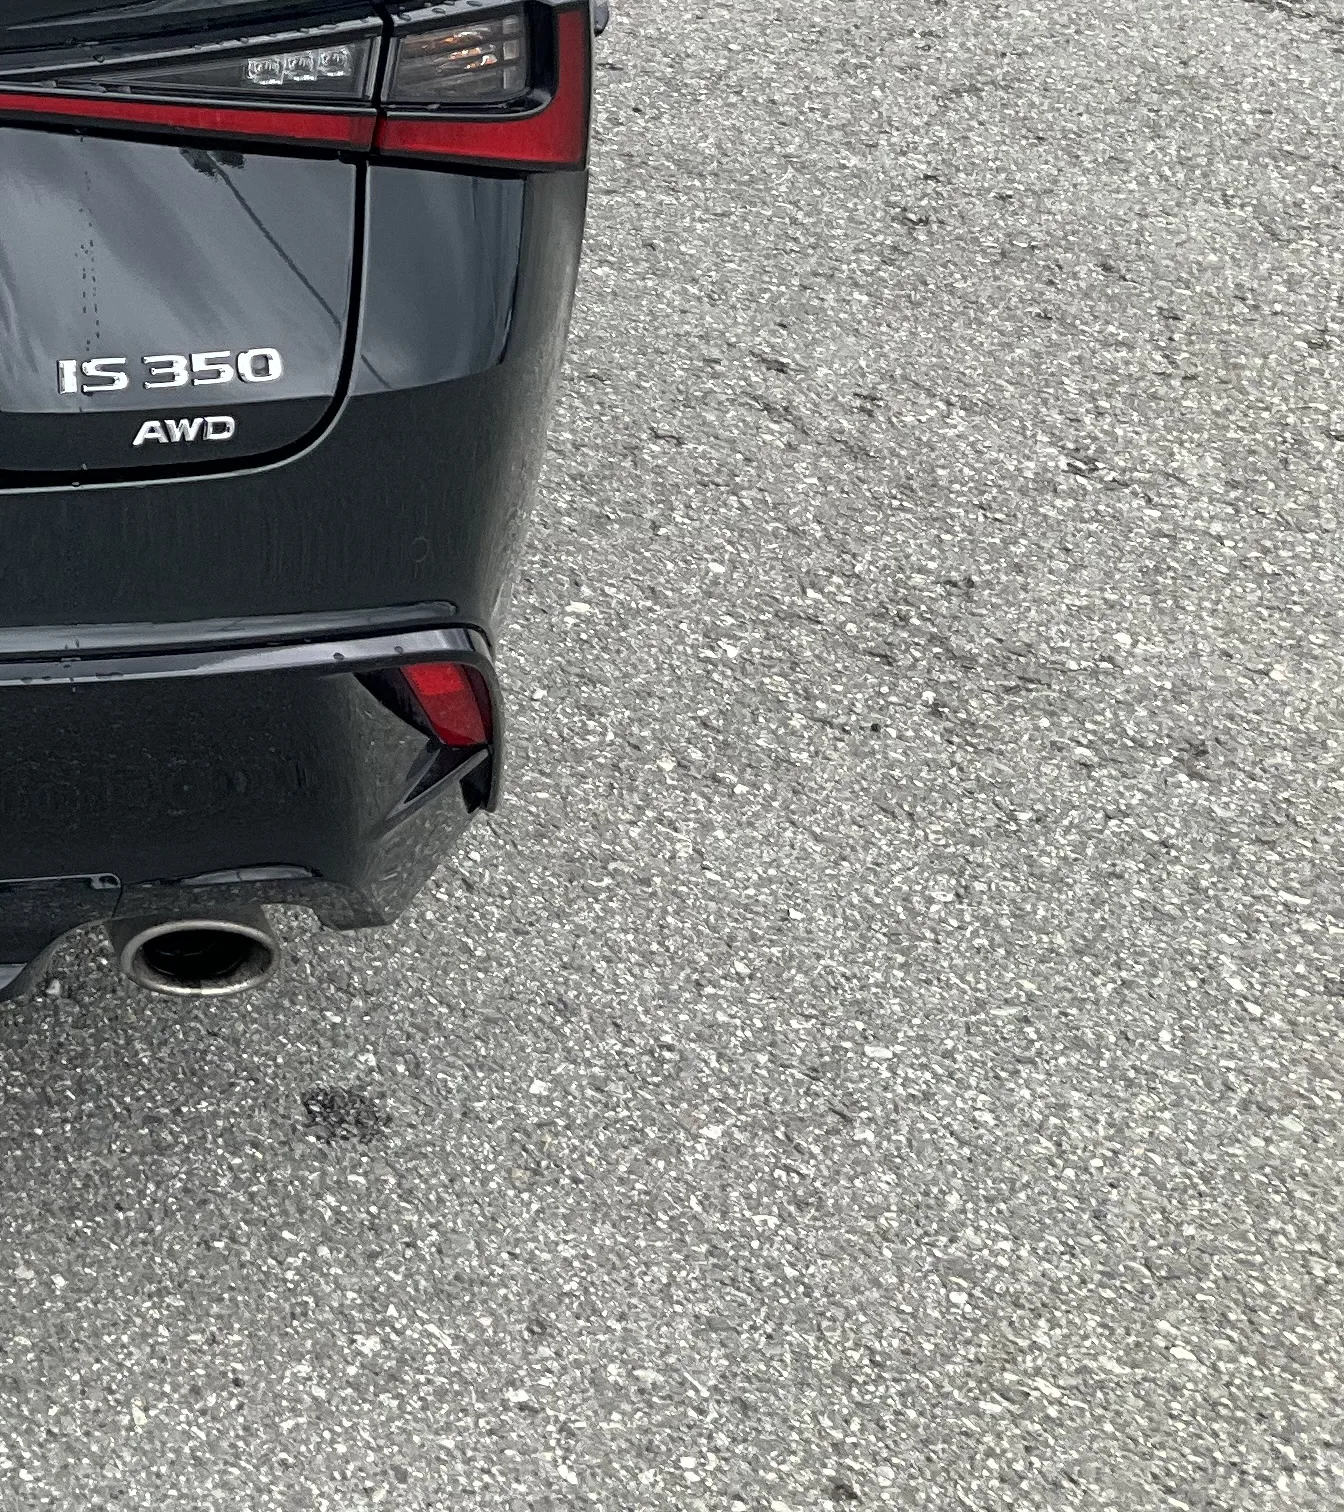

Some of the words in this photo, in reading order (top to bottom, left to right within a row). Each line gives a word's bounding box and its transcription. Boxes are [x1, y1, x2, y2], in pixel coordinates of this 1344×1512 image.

[57, 357, 129, 394] IS
[142, 347, 284, 389] 350
[132, 415, 236, 446] AWD
